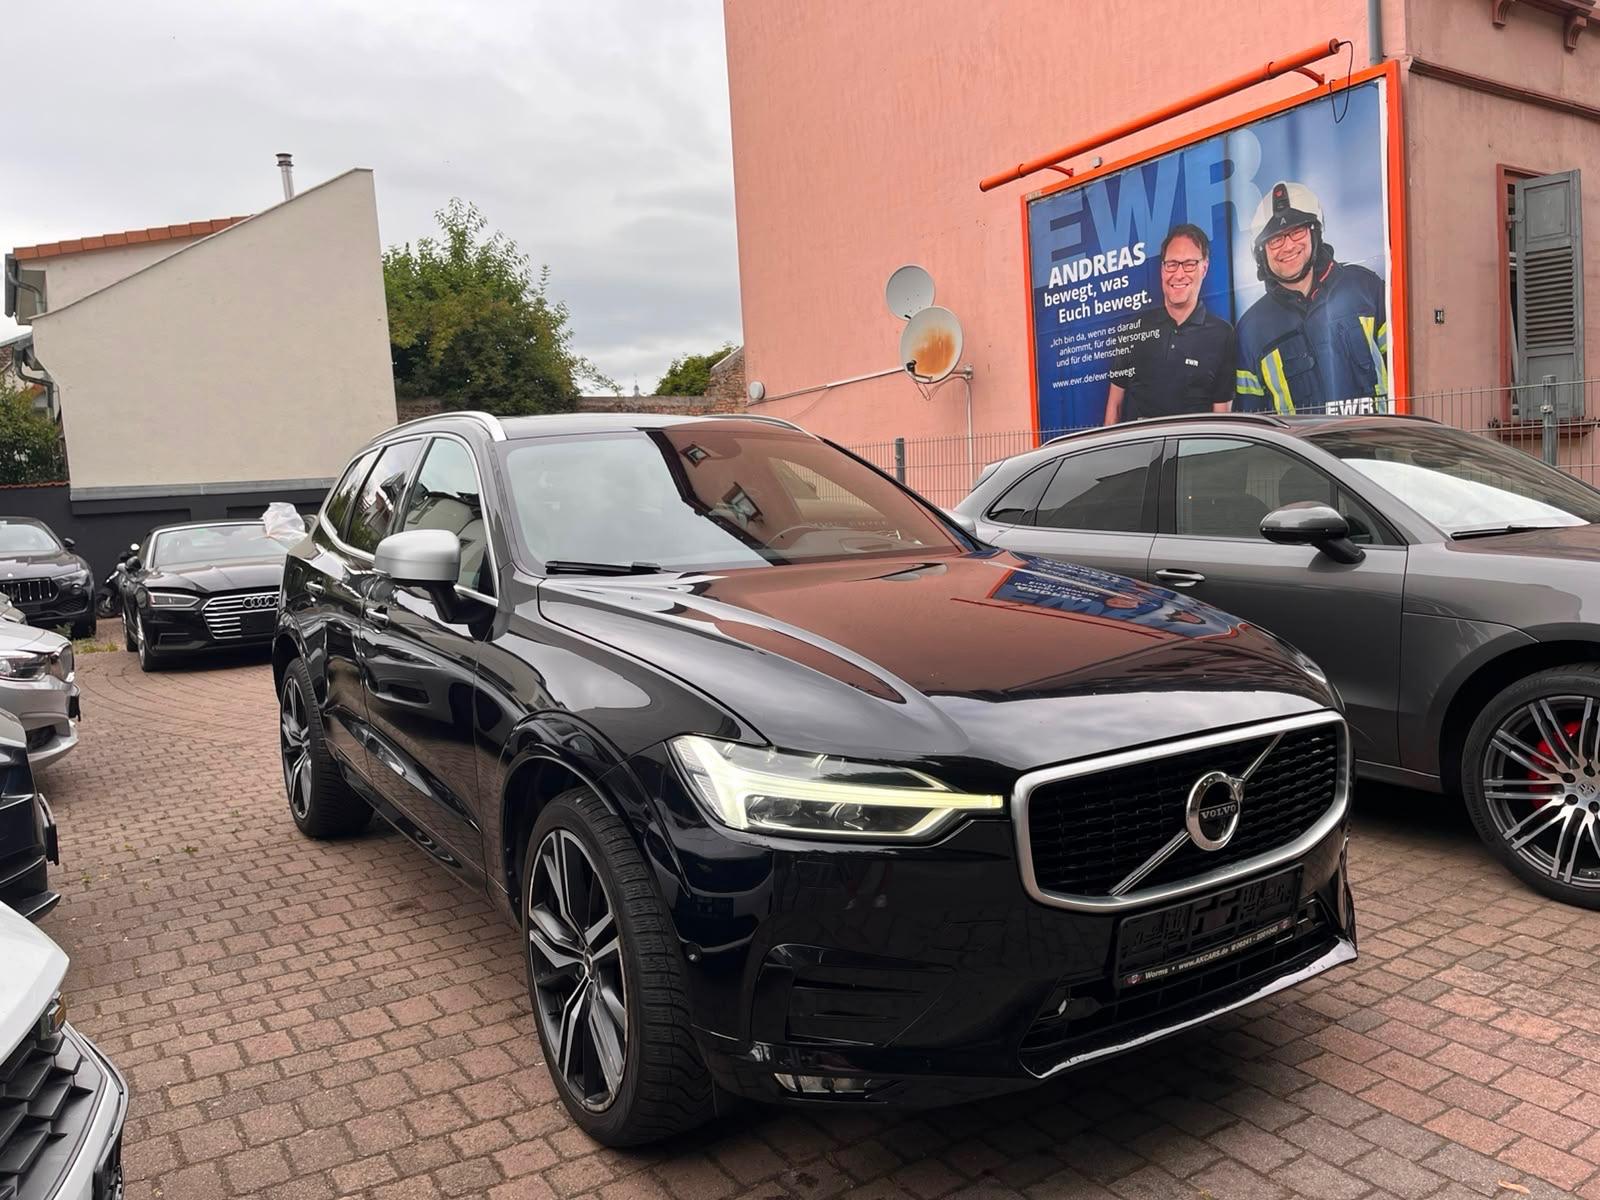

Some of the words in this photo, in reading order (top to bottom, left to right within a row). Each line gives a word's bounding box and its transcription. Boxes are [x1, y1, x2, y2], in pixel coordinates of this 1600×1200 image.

[1031, 129, 1262, 289] EWR
[1048, 242, 1147, 289] ANDREAS
[1044, 283, 1097, 307] bewegt,
[1100, 275, 1129, 293] was
[1059, 303, 1090, 323] Euch
[1095, 289, 1152, 316] bewegt.
[1059, 344, 1093, 356] ankommt,
[1094, 339, 1104, 350] für
[1105, 335, 1117, 347] die
[1118, 328, 1160, 344] Versorgung
[1064, 334, 1075, 344] bin
[1076, 331, 1086, 342] da,
[1088, 328, 1106, 339] wenn
[1107, 326, 1116, 334] es
[1117, 318, 1142, 333] darauf
[1056, 357, 1070, 368] und
[1070, 355, 1081, 365] für
[1081, 352, 1093, 363] die
[1052, 367, 1136, 389] www.ewr.de/ewr-bewegt
[1326, 397, 1374, 416] EWR
[1200, 804, 1237, 819] VOLVO
[1145, 968, 1169, 979] Worms
